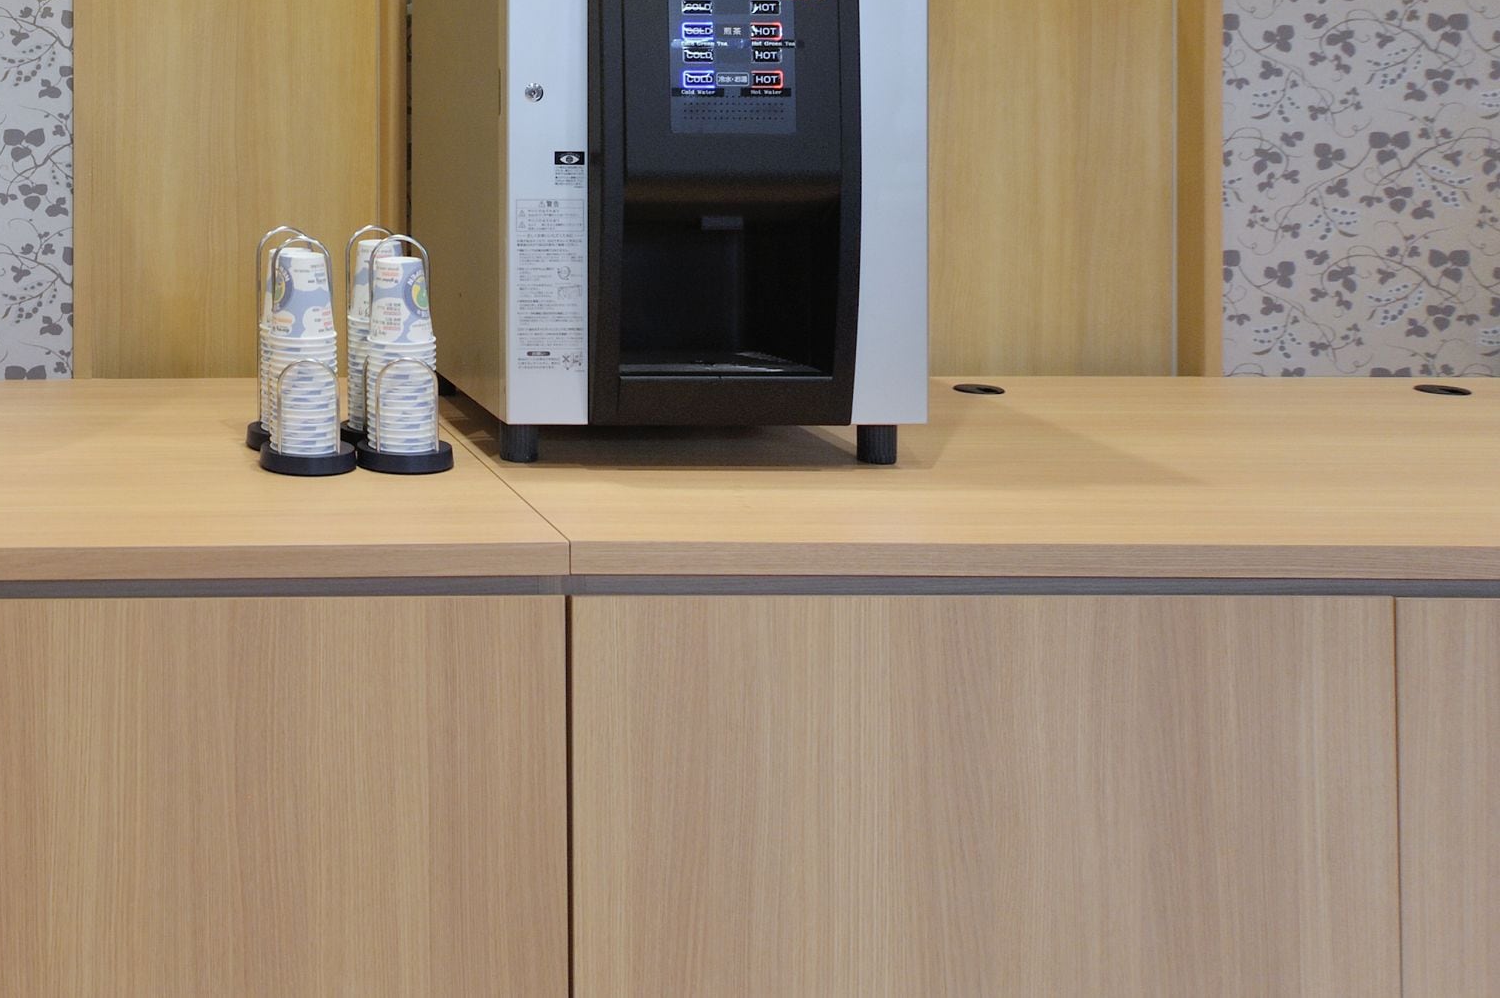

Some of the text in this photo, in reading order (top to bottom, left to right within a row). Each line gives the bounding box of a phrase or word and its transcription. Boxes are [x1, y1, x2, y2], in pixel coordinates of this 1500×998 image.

[685, 3, 712, 11] COLD
[756, 3, 776, 11] HOT
[686, 27, 712, 35] COLD
[723, 27, 741, 35] 煎茶
[755, 27, 776, 35] HOT
[686, 51, 712, 59] COLD
[755, 51, 777, 59] HOT
[686, 75, 713, 83] COLD
[756, 75, 778, 84] HOT
